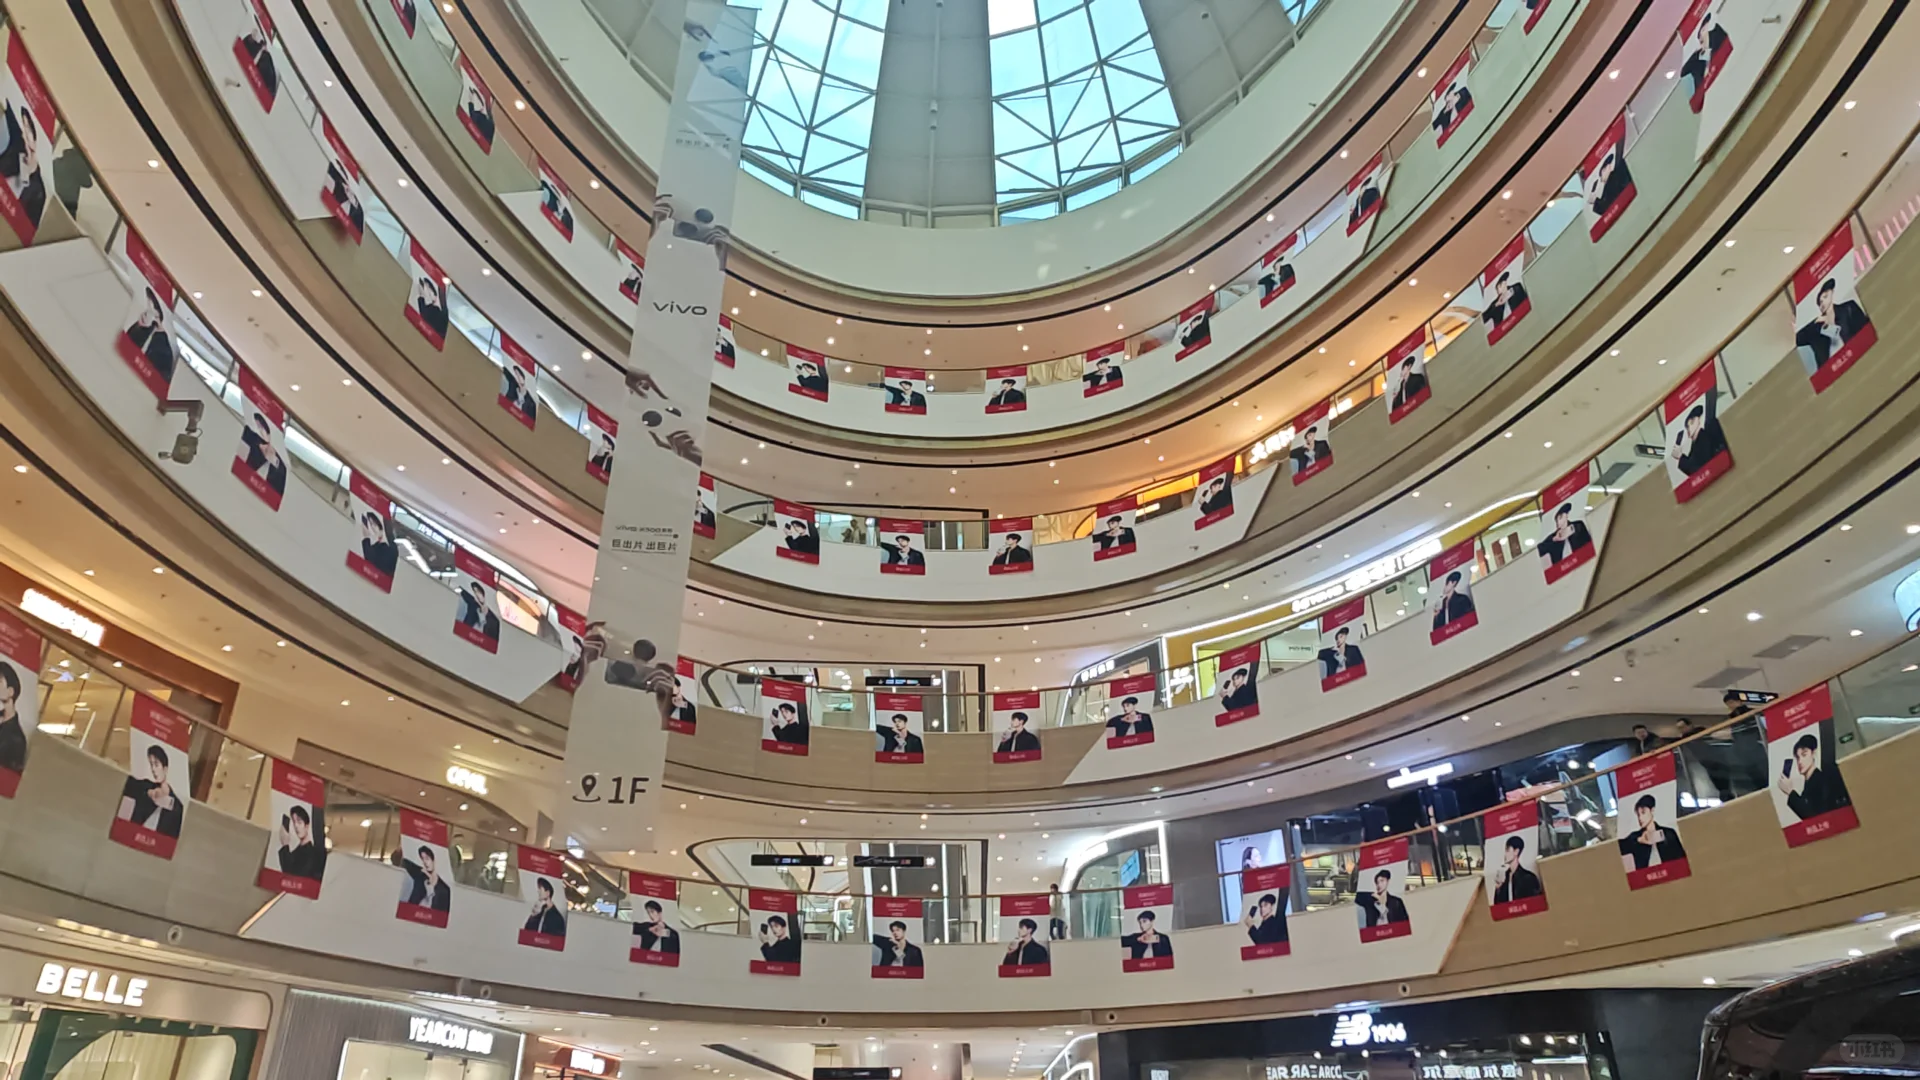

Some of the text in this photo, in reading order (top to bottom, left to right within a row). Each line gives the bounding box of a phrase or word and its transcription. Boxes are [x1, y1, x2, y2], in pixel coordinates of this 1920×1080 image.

[653, 301, 707, 315] vivo
[608, 776, 649, 804] 1F
[36, 962, 148, 1007] BELLE
[410, 1017, 468, 1049] YEARCON
